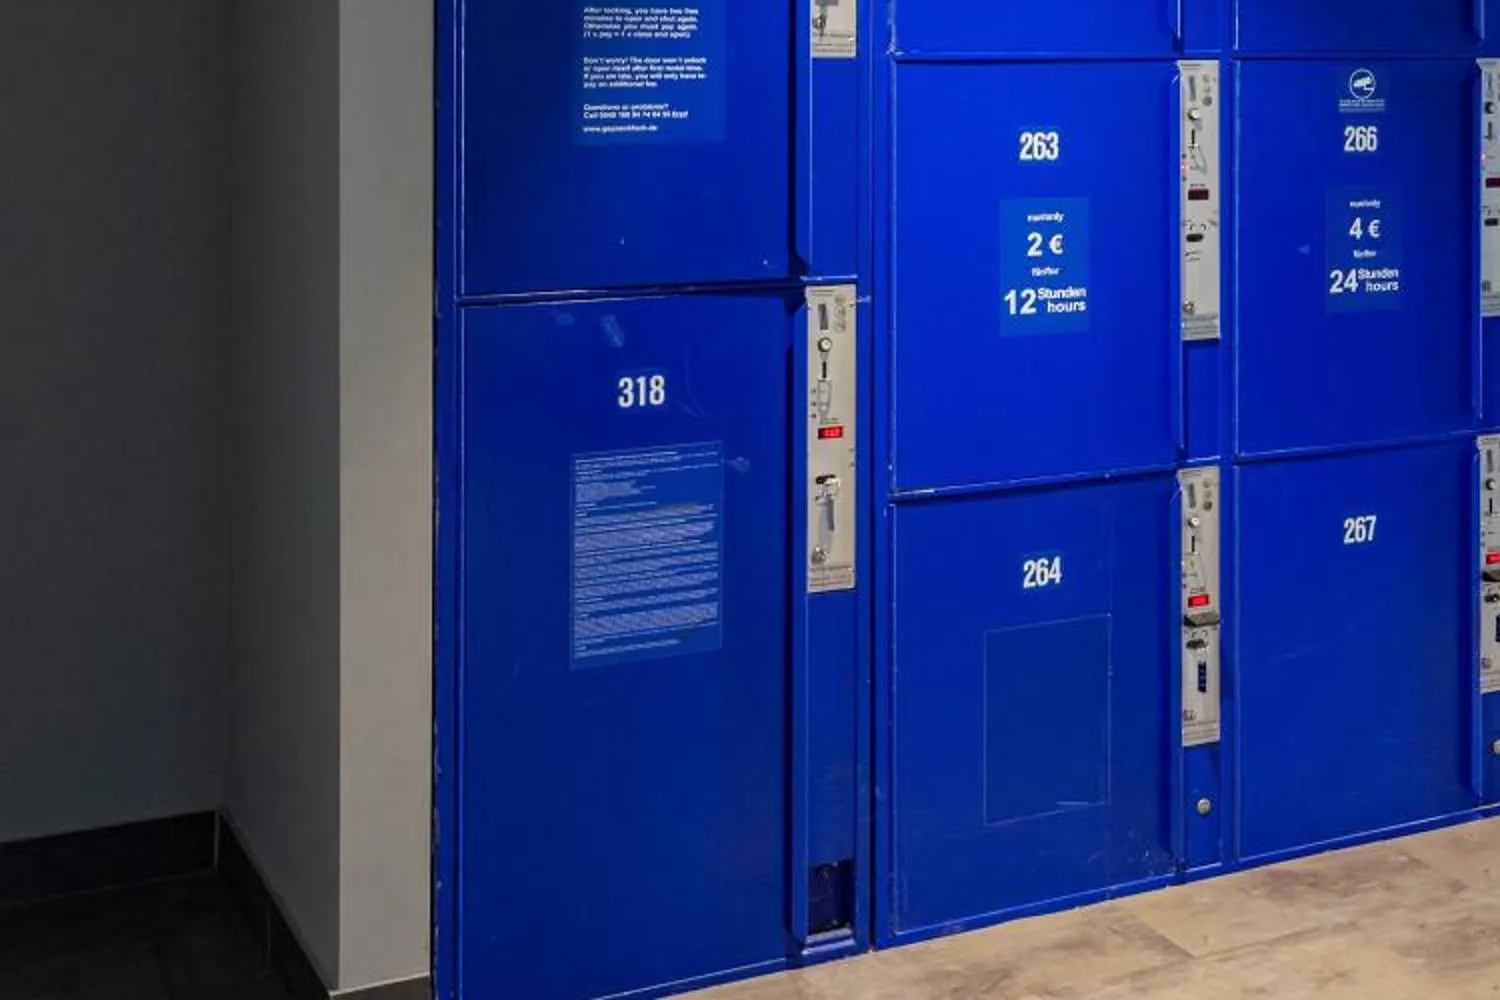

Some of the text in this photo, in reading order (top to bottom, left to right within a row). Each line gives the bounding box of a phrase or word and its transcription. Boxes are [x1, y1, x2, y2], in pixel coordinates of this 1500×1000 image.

[1020, 132, 1058, 160] 263
[1344, 126, 1377, 152] 266
[1349, 218, 1380, 239] 4 €
[1028, 232, 1063, 256] 2 €
[1329, 268, 1399, 293] 24 Stunden
[1365, 280, 1399, 292] hours
[1004, 286, 1086, 315] 12 Stunden
[1047, 300, 1086, 313] hours
[618, 375, 664, 407] 318
[1344, 515, 1376, 544] 267
[1024, 557, 1062, 588] 264
